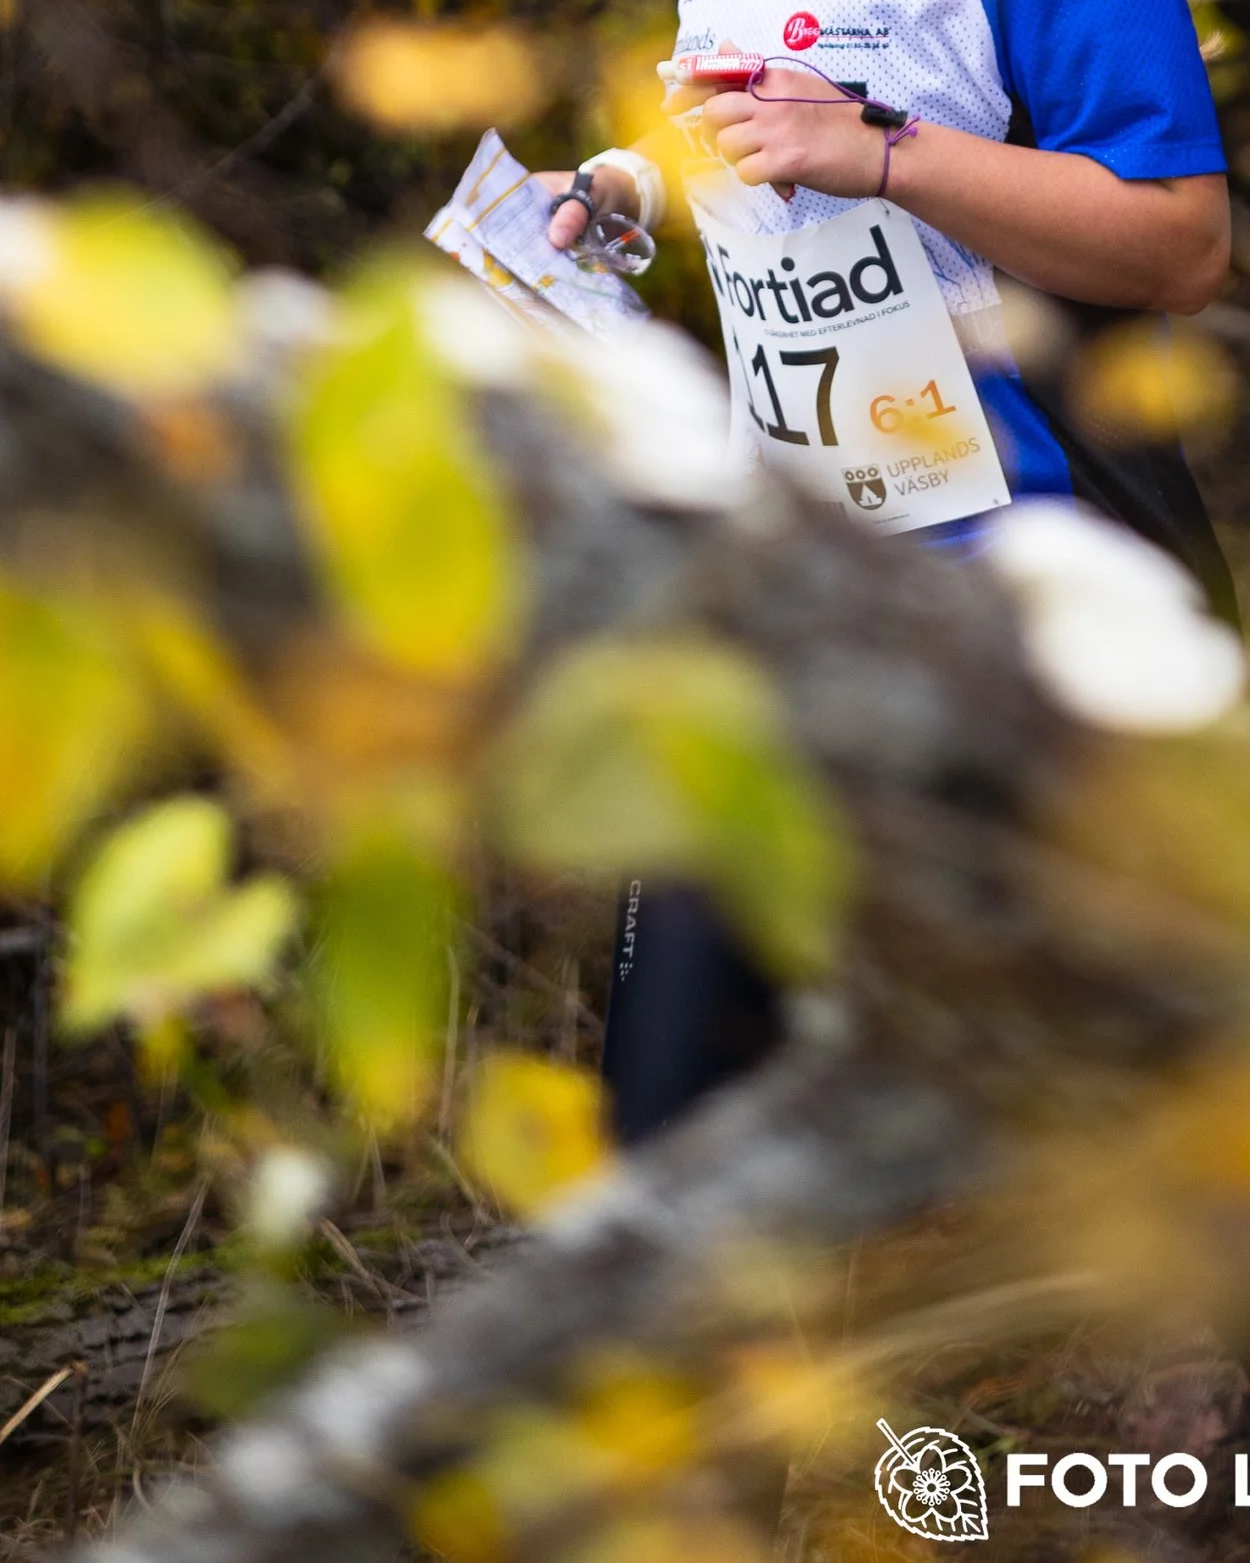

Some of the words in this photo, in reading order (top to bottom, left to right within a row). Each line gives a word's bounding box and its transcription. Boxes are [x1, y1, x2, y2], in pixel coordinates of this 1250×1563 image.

[881, 300, 911, 317] FOKUS
[886, 437, 982, 478] UPPLANDS
[894, 468, 951, 496] VÄSBY
[622, 879, 642, 959] CRAFT
